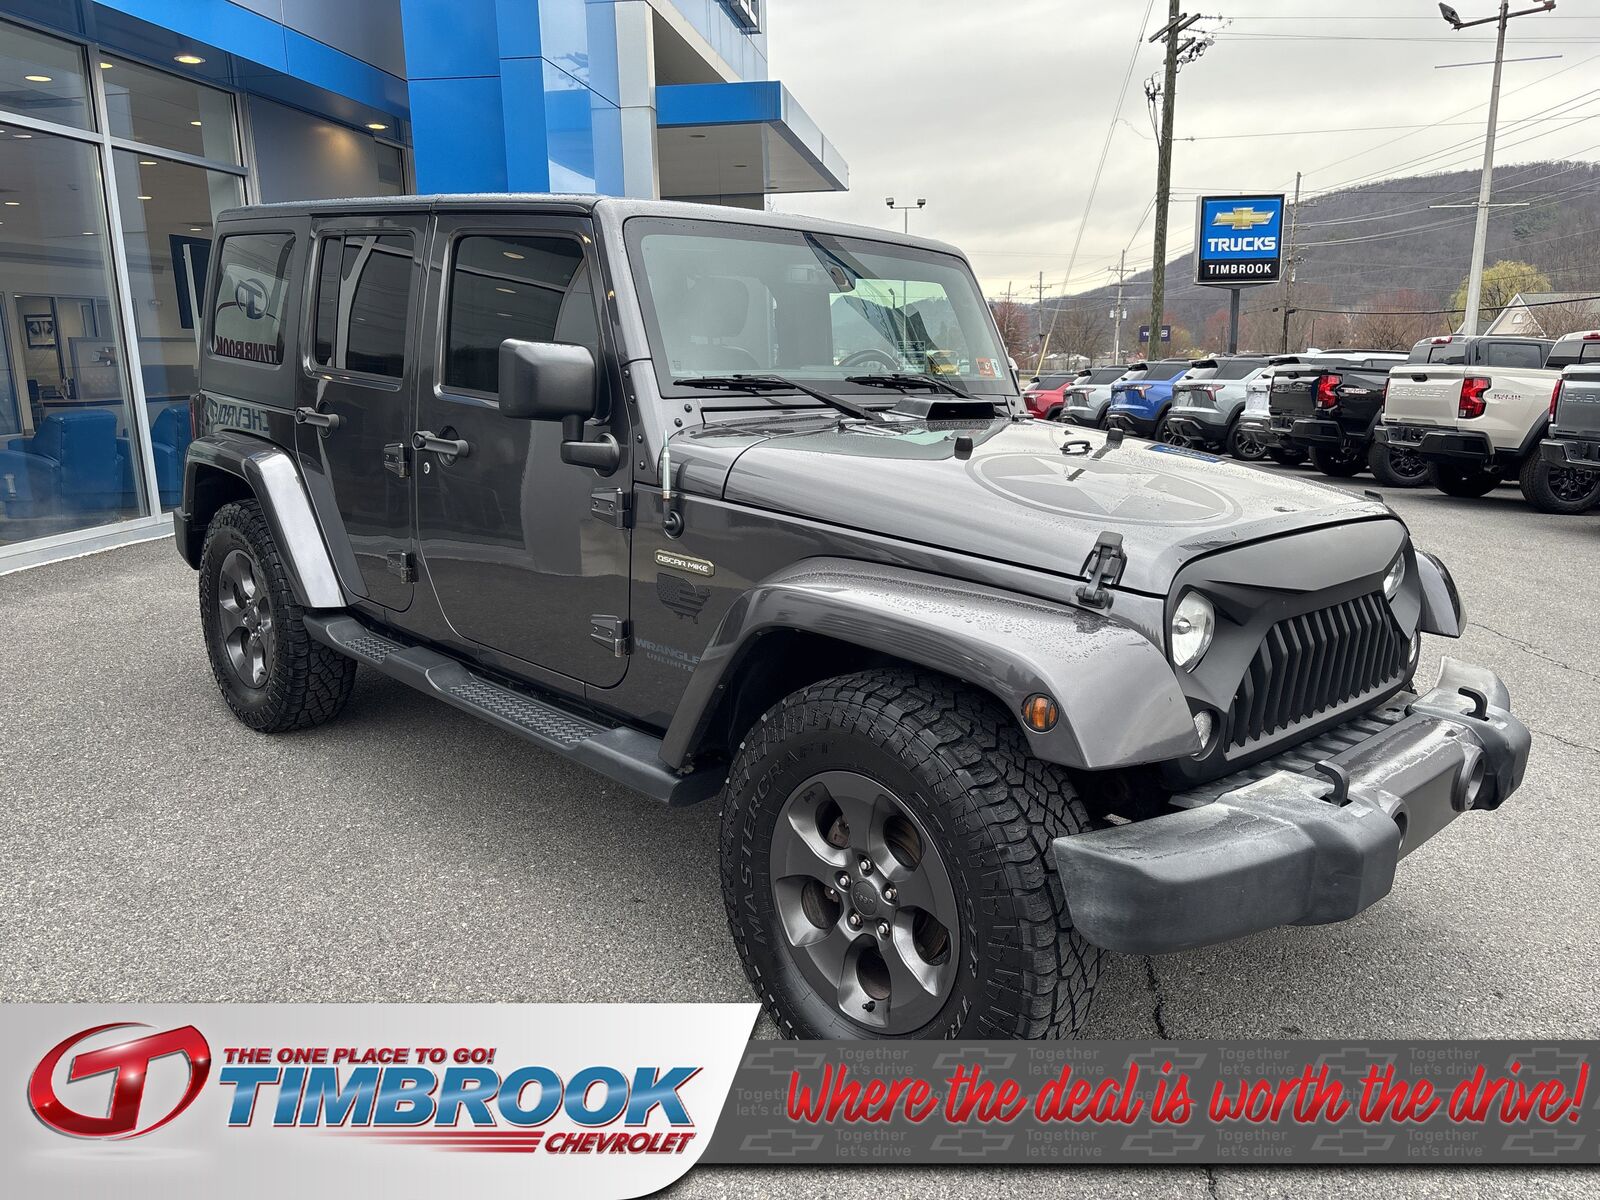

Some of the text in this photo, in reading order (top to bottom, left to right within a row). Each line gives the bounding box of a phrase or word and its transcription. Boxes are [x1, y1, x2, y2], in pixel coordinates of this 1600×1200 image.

[1208, 237, 1276, 252] TRUCKS
[1209, 264, 1272, 275] TIMBROOK
[657, 554, 709, 573] OSCAR MIKE
